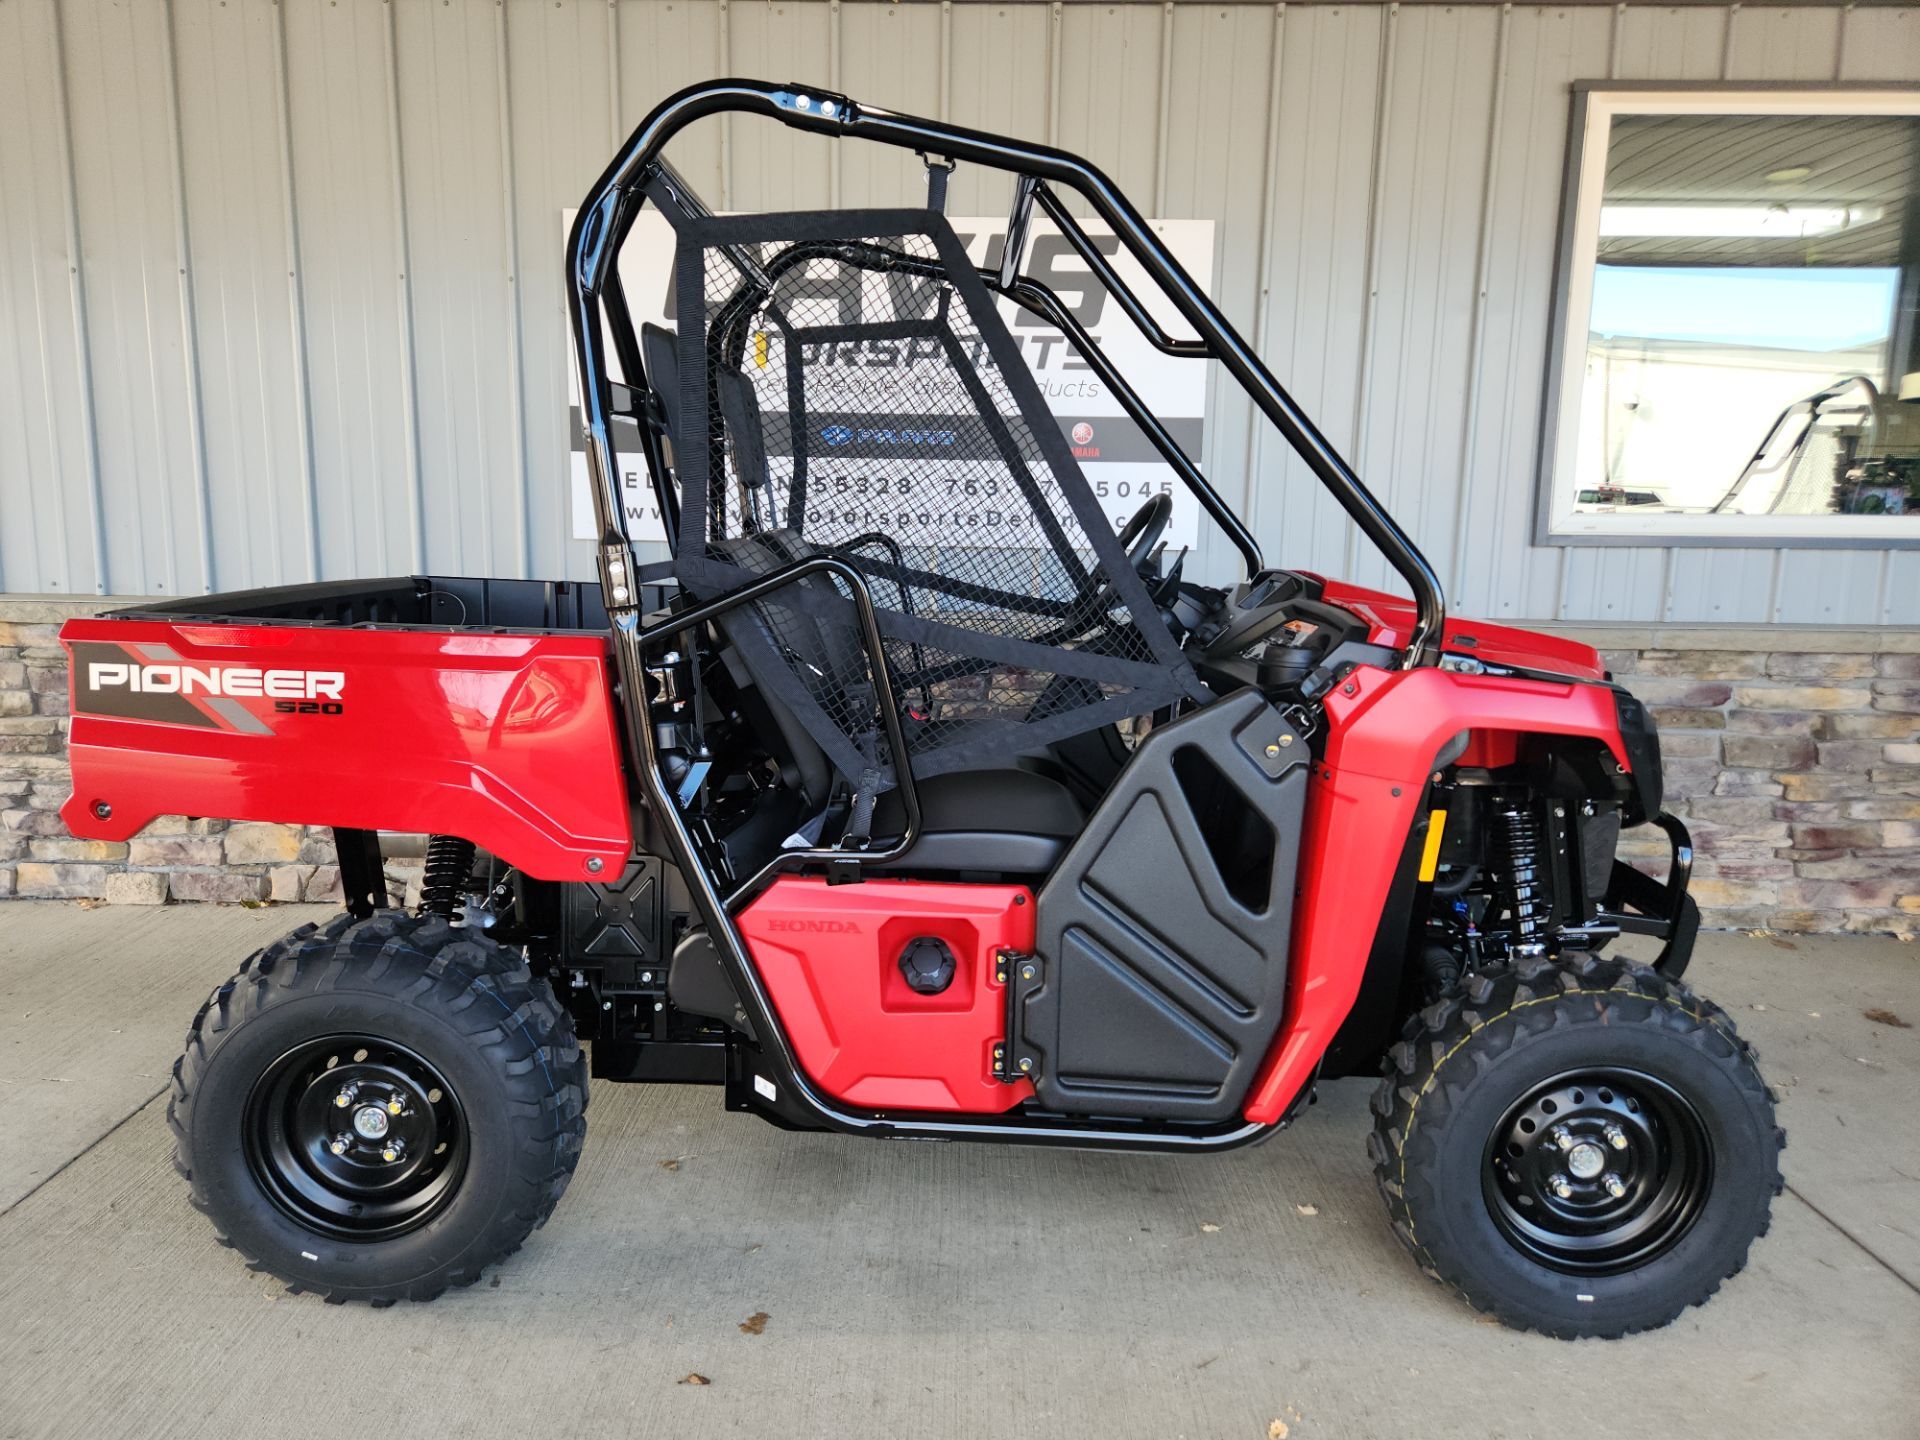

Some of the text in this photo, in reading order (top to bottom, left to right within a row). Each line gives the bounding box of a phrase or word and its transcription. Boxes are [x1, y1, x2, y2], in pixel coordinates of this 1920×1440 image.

[1070, 446, 1100, 457] AMAHA
[813, 475, 911, 495] 55328
[88, 662, 345, 700] PIONEER
[274, 700, 344, 715] 520
[767, 919, 864, 934] HONDA
